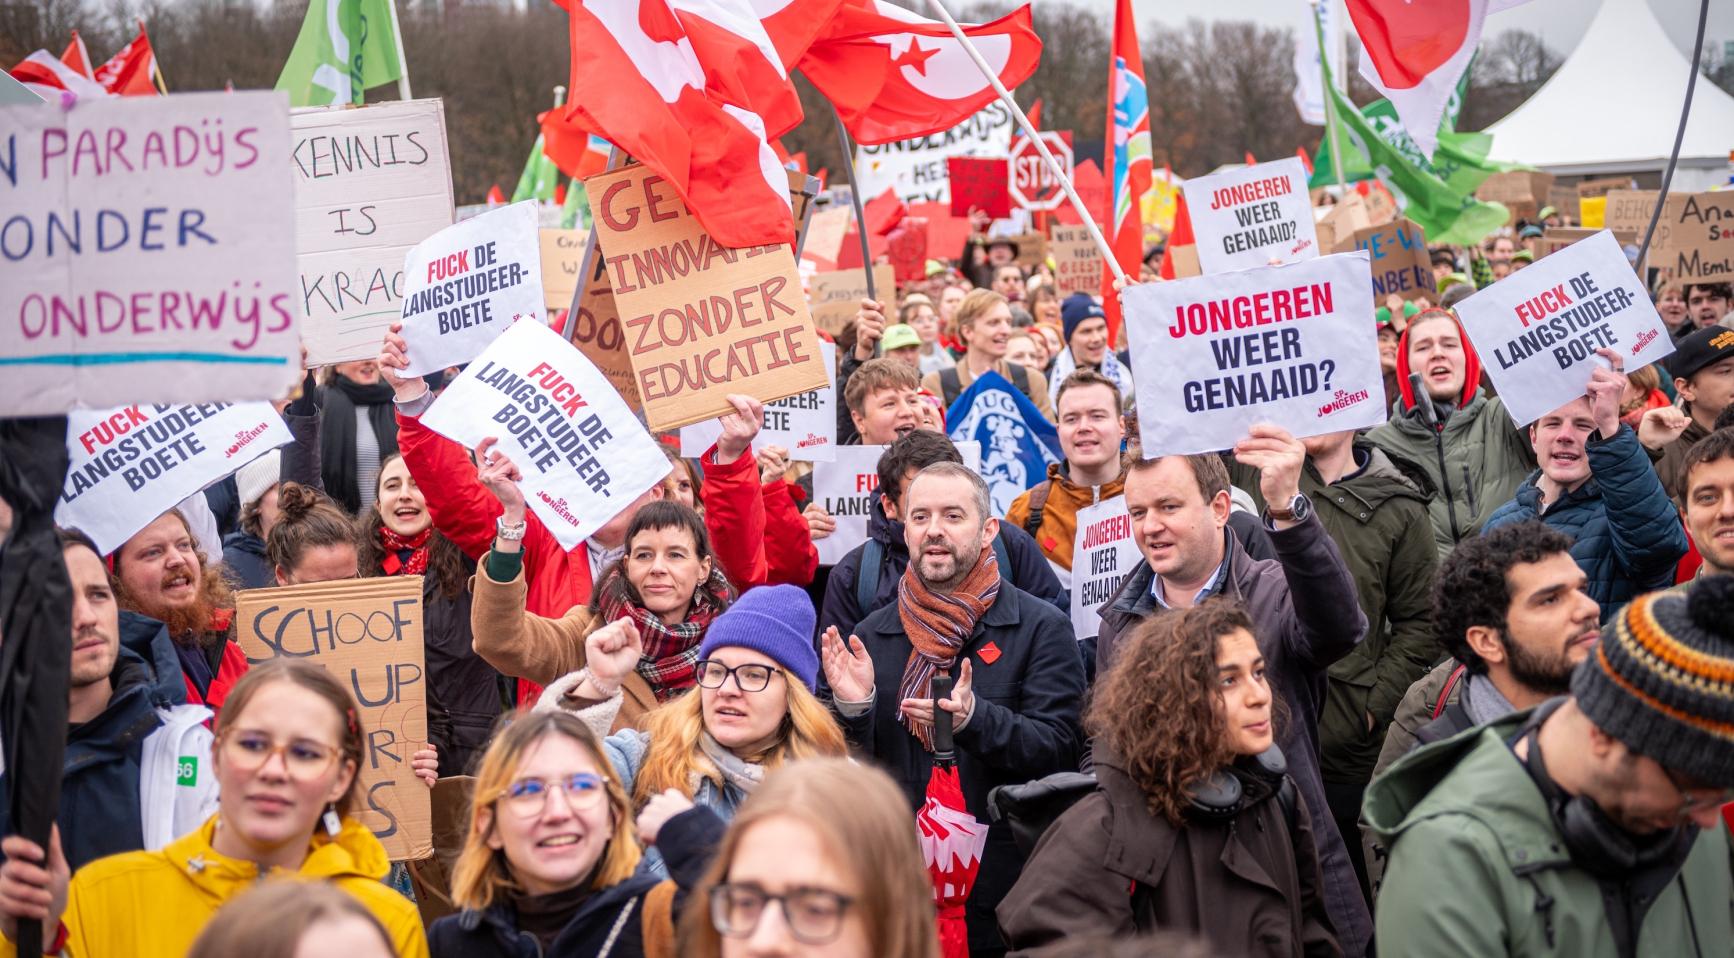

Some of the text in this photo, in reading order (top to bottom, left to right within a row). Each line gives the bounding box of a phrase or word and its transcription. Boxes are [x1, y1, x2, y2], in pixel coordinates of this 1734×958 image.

[601, 175, 694, 232] GE
[1211, 175, 1292, 210] JONGEREN
[1235, 201, 1281, 228] WEER
[328, 205, 377, 236] IS
[1222, 220, 1297, 255] GENAAID?
[427, 241, 497, 284] FUCK DE
[403, 262, 529, 318] LANGSTUDEER-
[438, 299, 493, 335] BOETE
[626, 275, 796, 356] ZONDER
[1168, 282, 1334, 339] JONGEREN
[1514, 271, 1599, 328] FUCK DE
[1210, 327, 1302, 371] WEER
[1493, 286, 1635, 371] LANGSTUDEER-
[1553, 323, 1618, 370] BOETE
[639, 324, 810, 401] EDUCATIE
[1183, 359, 1336, 413] GENAAID?
[79, 403, 149, 456] FUCK
[474, 361, 611, 498] LANGSTUDEER-
[527, 361, 613, 451] FUCK DE
[122, 431, 206, 492] BOETE
[492, 401, 561, 474] BOETE
[1083, 514, 1130, 550] JONGEREN
[1091, 547, 1117, 576] WEER
[247, 599, 418, 664] SCHOOF
[351, 663, 422, 708] UP
